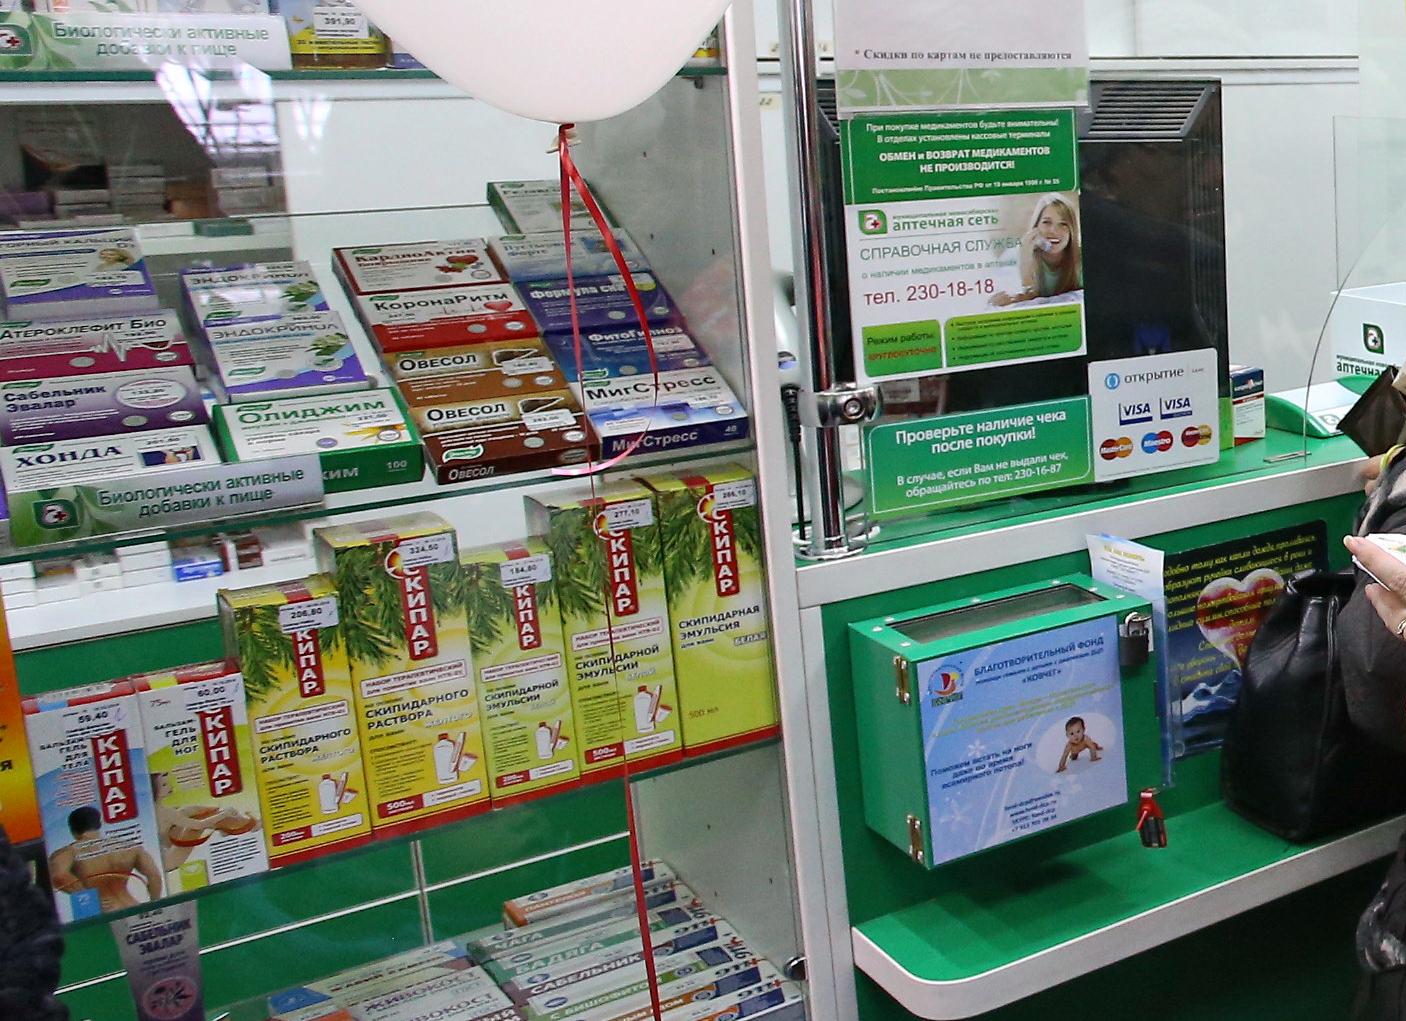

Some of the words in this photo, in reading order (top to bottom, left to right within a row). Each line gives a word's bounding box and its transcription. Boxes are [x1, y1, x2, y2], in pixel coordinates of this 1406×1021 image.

[185, 24, 269, 41] активные
[176, 44, 187, 55] к
[190, 44, 238, 58] пище
[863, 49, 909, 60] Скидки
[911, 52, 924, 62] по
[927, 51, 967, 62] картам
[969, 52, 982, 60] не
[984, 51, 1073, 63] предоставляются
[866, 123, 884, 132] При
[885, 123, 920, 133] покупке
[920, 121, 979, 131] медикаментов
[979, 119, 1007, 130] будьте
[1006, 118, 1060, 128] внимательны!
[876, 135, 884, 143] В
[884, 134, 918, 145] отделах
[918, 133, 971, 143] установлены
[971, 132, 1007, 140] кассовые
[1007, 130, 1052, 141] терминалы
[879, 152, 918, 163] ОБМЕН
[917, 153, 926, 161] и
[926, 150, 971, 161] ВОЗВРАТ
[971, 146, 1052, 159] МЕДИКАМЕНТОВ
[919, 163, 934, 174] НЕ
[934, 160, 1016, 174] ПРОИЗВОДИТСЯ!
[892, 216, 965, 232] аптечная
[967, 215, 999, 227] сеть
[859, 240, 962, 262] СПРАВОЧНАЯ
[965, 236, 1023, 252] СЛУЖБА
[375, 292, 509, 312] КоронаРитм
[864, 289, 901, 307] тел.
[906, 278, 995, 303] 230-18-18
[866, 331, 899, 346] Режим
[1124, 367, 1185, 385] открытие
[3, 385, 108, 402] Сабельник
[585, 374, 717, 401] МигСтресс
[6, 400, 77, 414] Эвалар
[1123, 402, 1152, 418] VISA
[1164, 397, 1192, 412] VISA
[895, 421, 975, 446] Проверьте
[975, 415, 1035, 435] наличие
[1036, 409, 1067, 424] чека
[931, 439, 974, 455] после
[975, 427, 1037, 449] покупки!
[16, 446, 123, 469] ХОНДА
[896, 475, 905, 486] В
[905, 470, 947, 487] случае,
[947, 466, 973, 479] если
[974, 460, 993, 473] Вам
[994, 462, 1008, 473] не
[1009, 455, 1045, 471] выдали
[1046, 453, 1070, 468] чек,
[99, 477, 221, 507] Биологически
[226, 468, 305, 490] активные
[905, 479, 977, 500] обращайтесь
[978, 474, 993, 489] по
[994, 471, 1014, 485] тел:
[1014, 463, 1063, 481] 230-16-87
[138, 494, 211, 519] добавки
[215, 493, 226, 506] к
[229, 487, 274, 507] пище
[711, 508, 739, 595] СКИПАР
[516, 584, 541, 648] КИПАР
[678, 605, 761, 630] СКИПИДАРНАЯ
[678, 620, 741, 641] ЭМУЛЬСИЯ
[296, 629, 322, 696] КИПАР
[575, 642, 660, 670] СКИПИДАРНОЙ
[973, 641, 1077, 677] БЛАГОТВОРИТЕЛЬНЫЙ
[1076, 636, 1105, 650] ФОНД
[575, 660, 639, 681] ЭМУЛЬСИИ
[484, 678, 559, 702] СКИПИДАРНОЙ
[365, 688, 470, 719] СКИПИДАРНОГО
[485, 694, 541, 712] ЭМУЛЬСИИ
[367, 709, 434, 731] РАСТВОРА
[164, 727, 197, 739] ГЕЛЬ
[171, 735, 198, 748] ДЛЯ
[259, 727, 352, 755] СКИПИДАРНОГО
[58, 742, 88, 755] ГЕЛЬ
[65, 751, 89, 763] ДЛЯ
[174, 745, 200, 756] НОГ
[204, 713, 234, 797] КИПАР
[260, 745, 320, 765] РАСТВОРА
[62, 759, 91, 770] ТЕЛА
[98, 734, 129, 820] КИПАР
[530, 952, 642, 995] САБЕЛЬНИК
